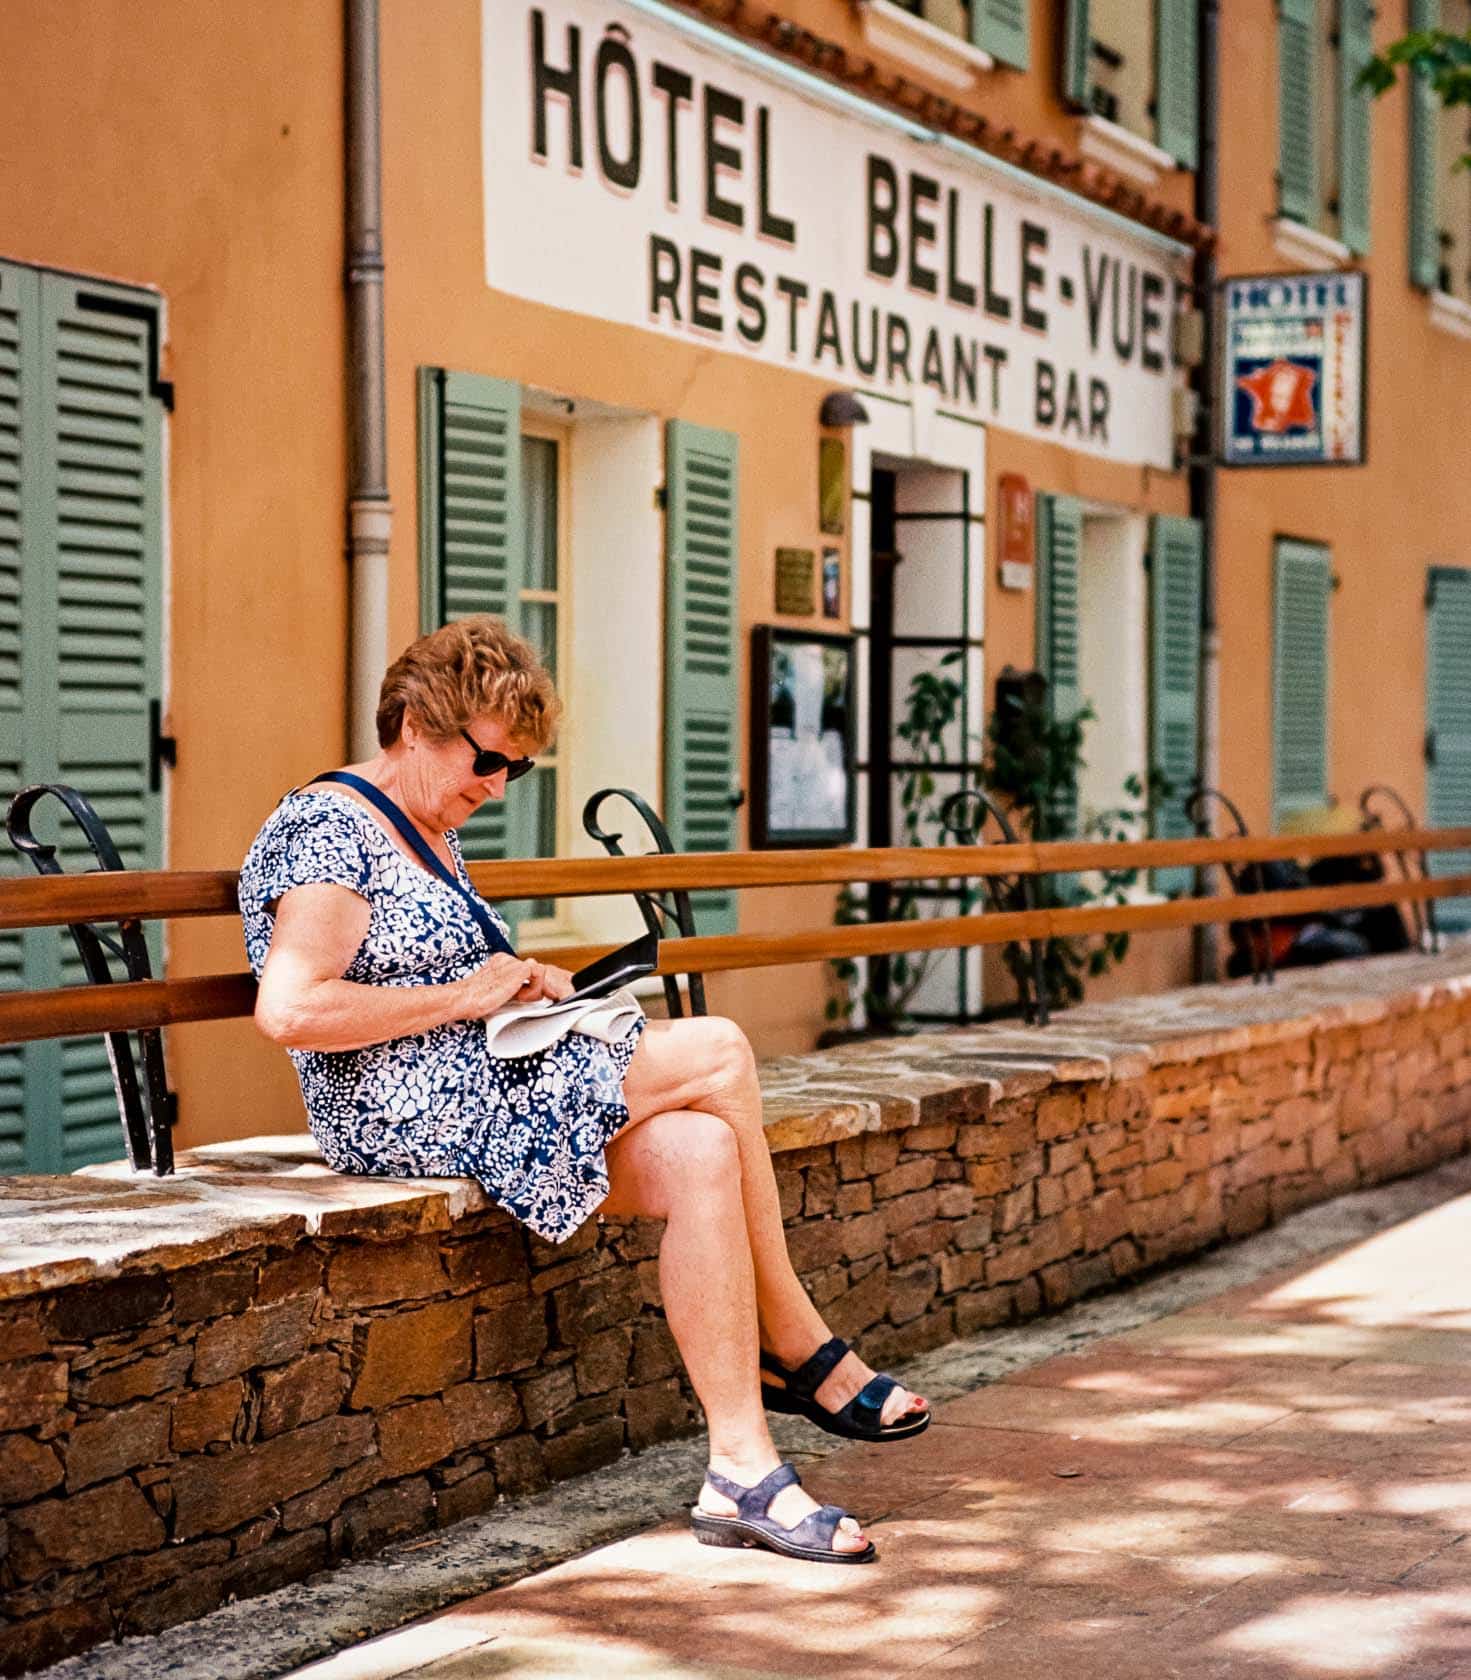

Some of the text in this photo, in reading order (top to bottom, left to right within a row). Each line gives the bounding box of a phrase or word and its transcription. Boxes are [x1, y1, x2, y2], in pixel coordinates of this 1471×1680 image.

[530, 7, 1166, 373] HÔTEL BELLE-VUE
[650, 232, 1112, 448] RESTAURANT BAR
